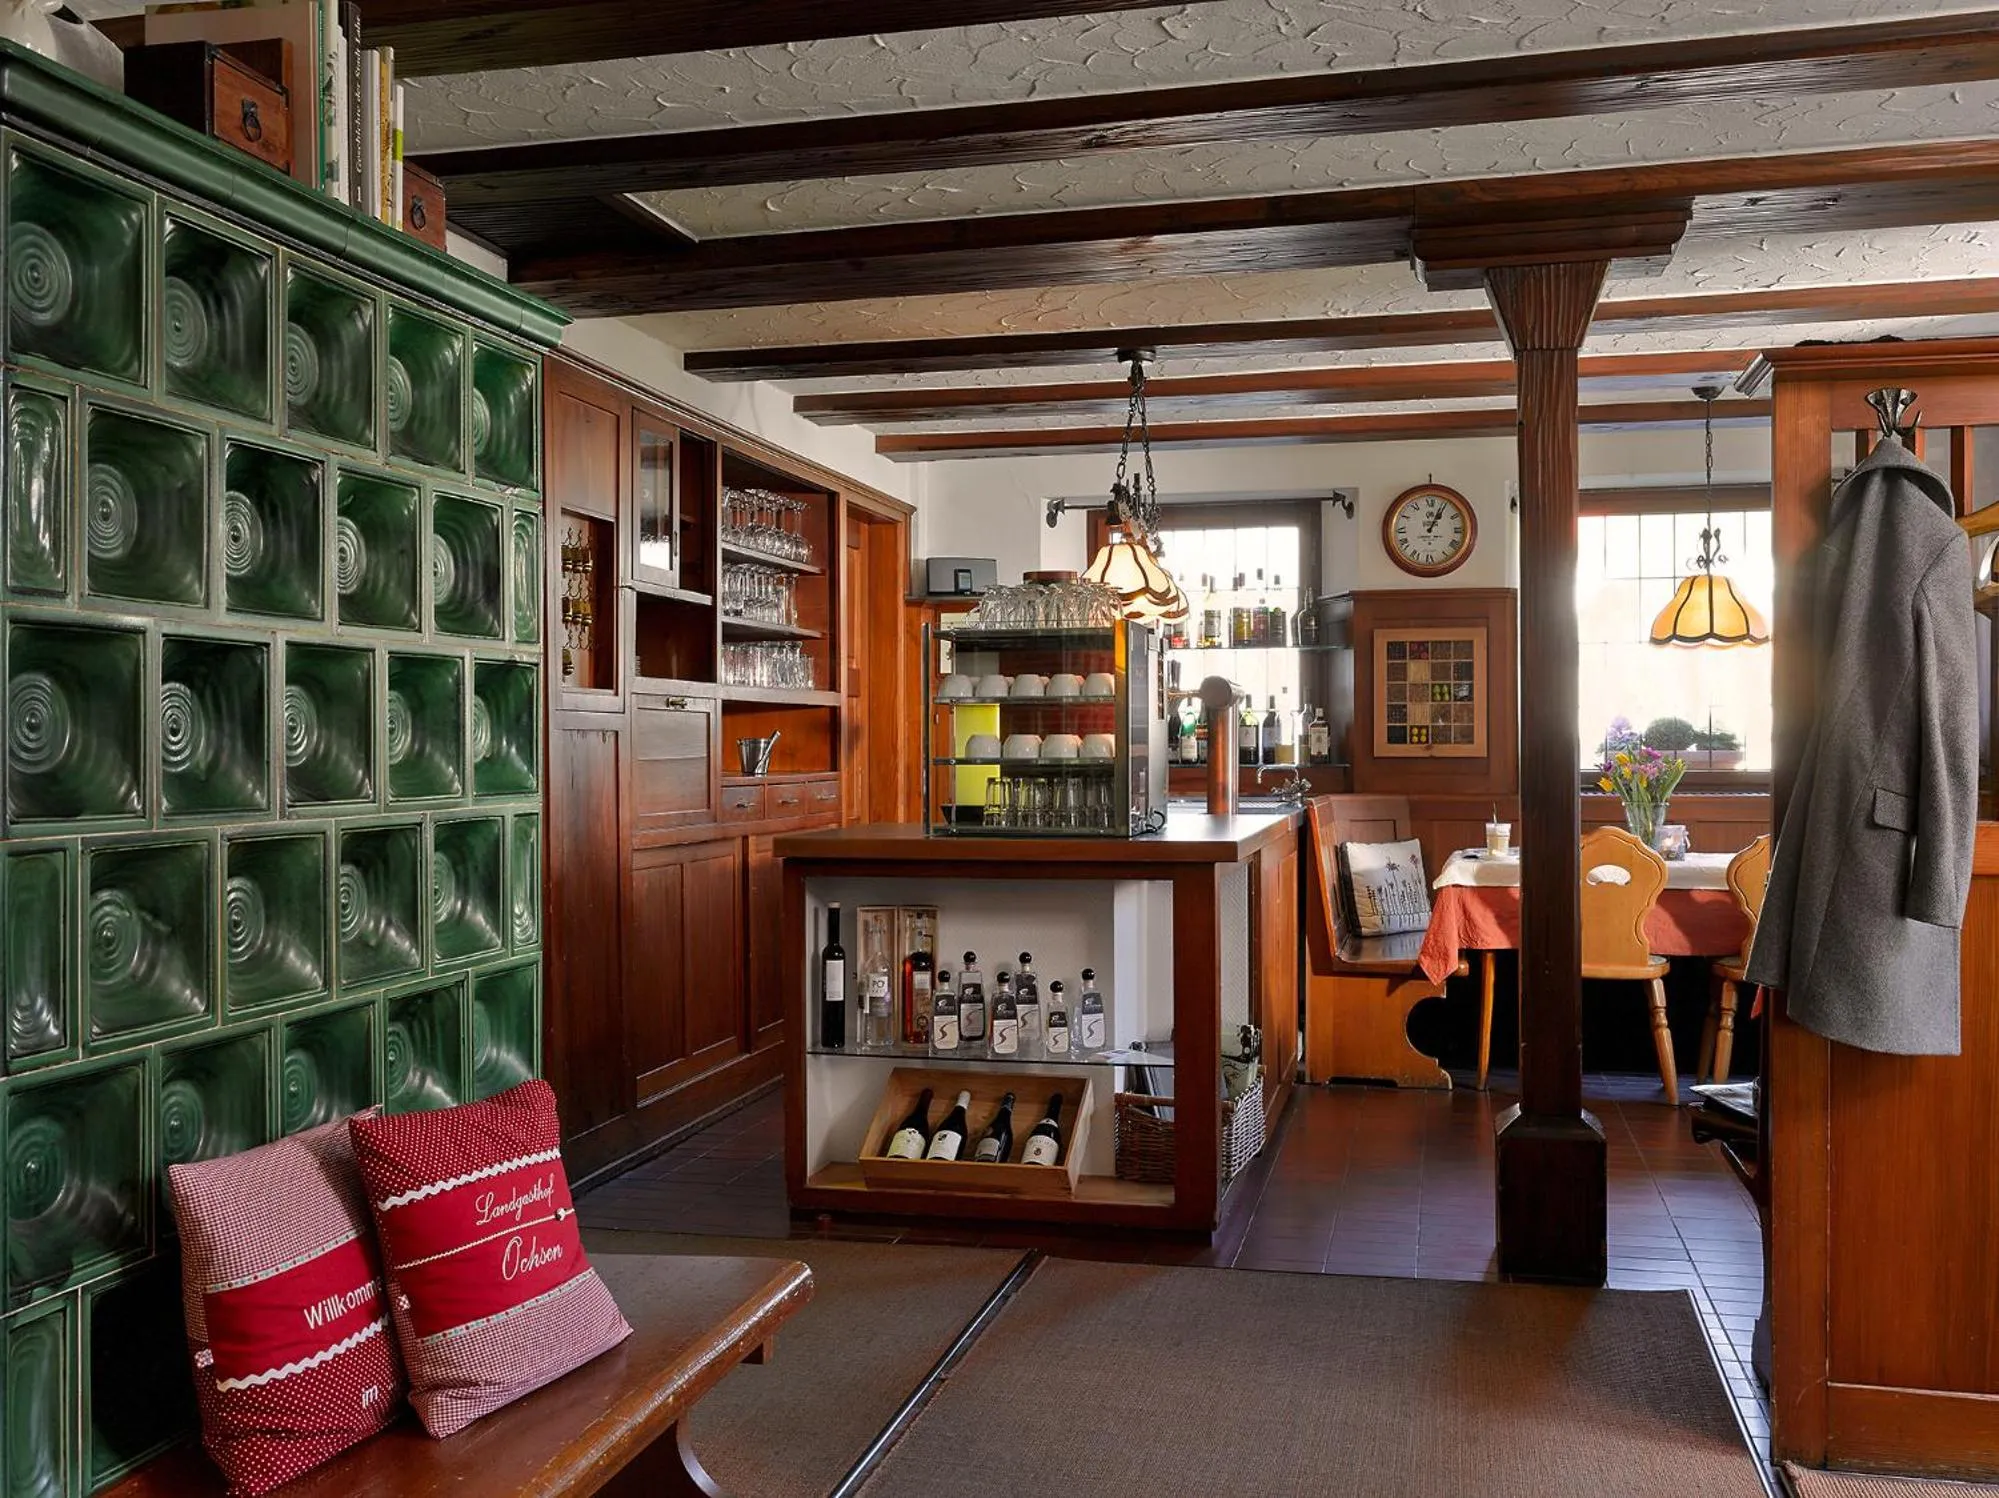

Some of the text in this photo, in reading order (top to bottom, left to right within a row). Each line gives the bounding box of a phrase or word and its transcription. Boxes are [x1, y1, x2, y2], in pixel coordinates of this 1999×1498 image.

[475, 1172, 555, 1226] Landgasthof
[502, 1236, 563, 1281] Ochsen
[362, 1385, 378, 1409] im
